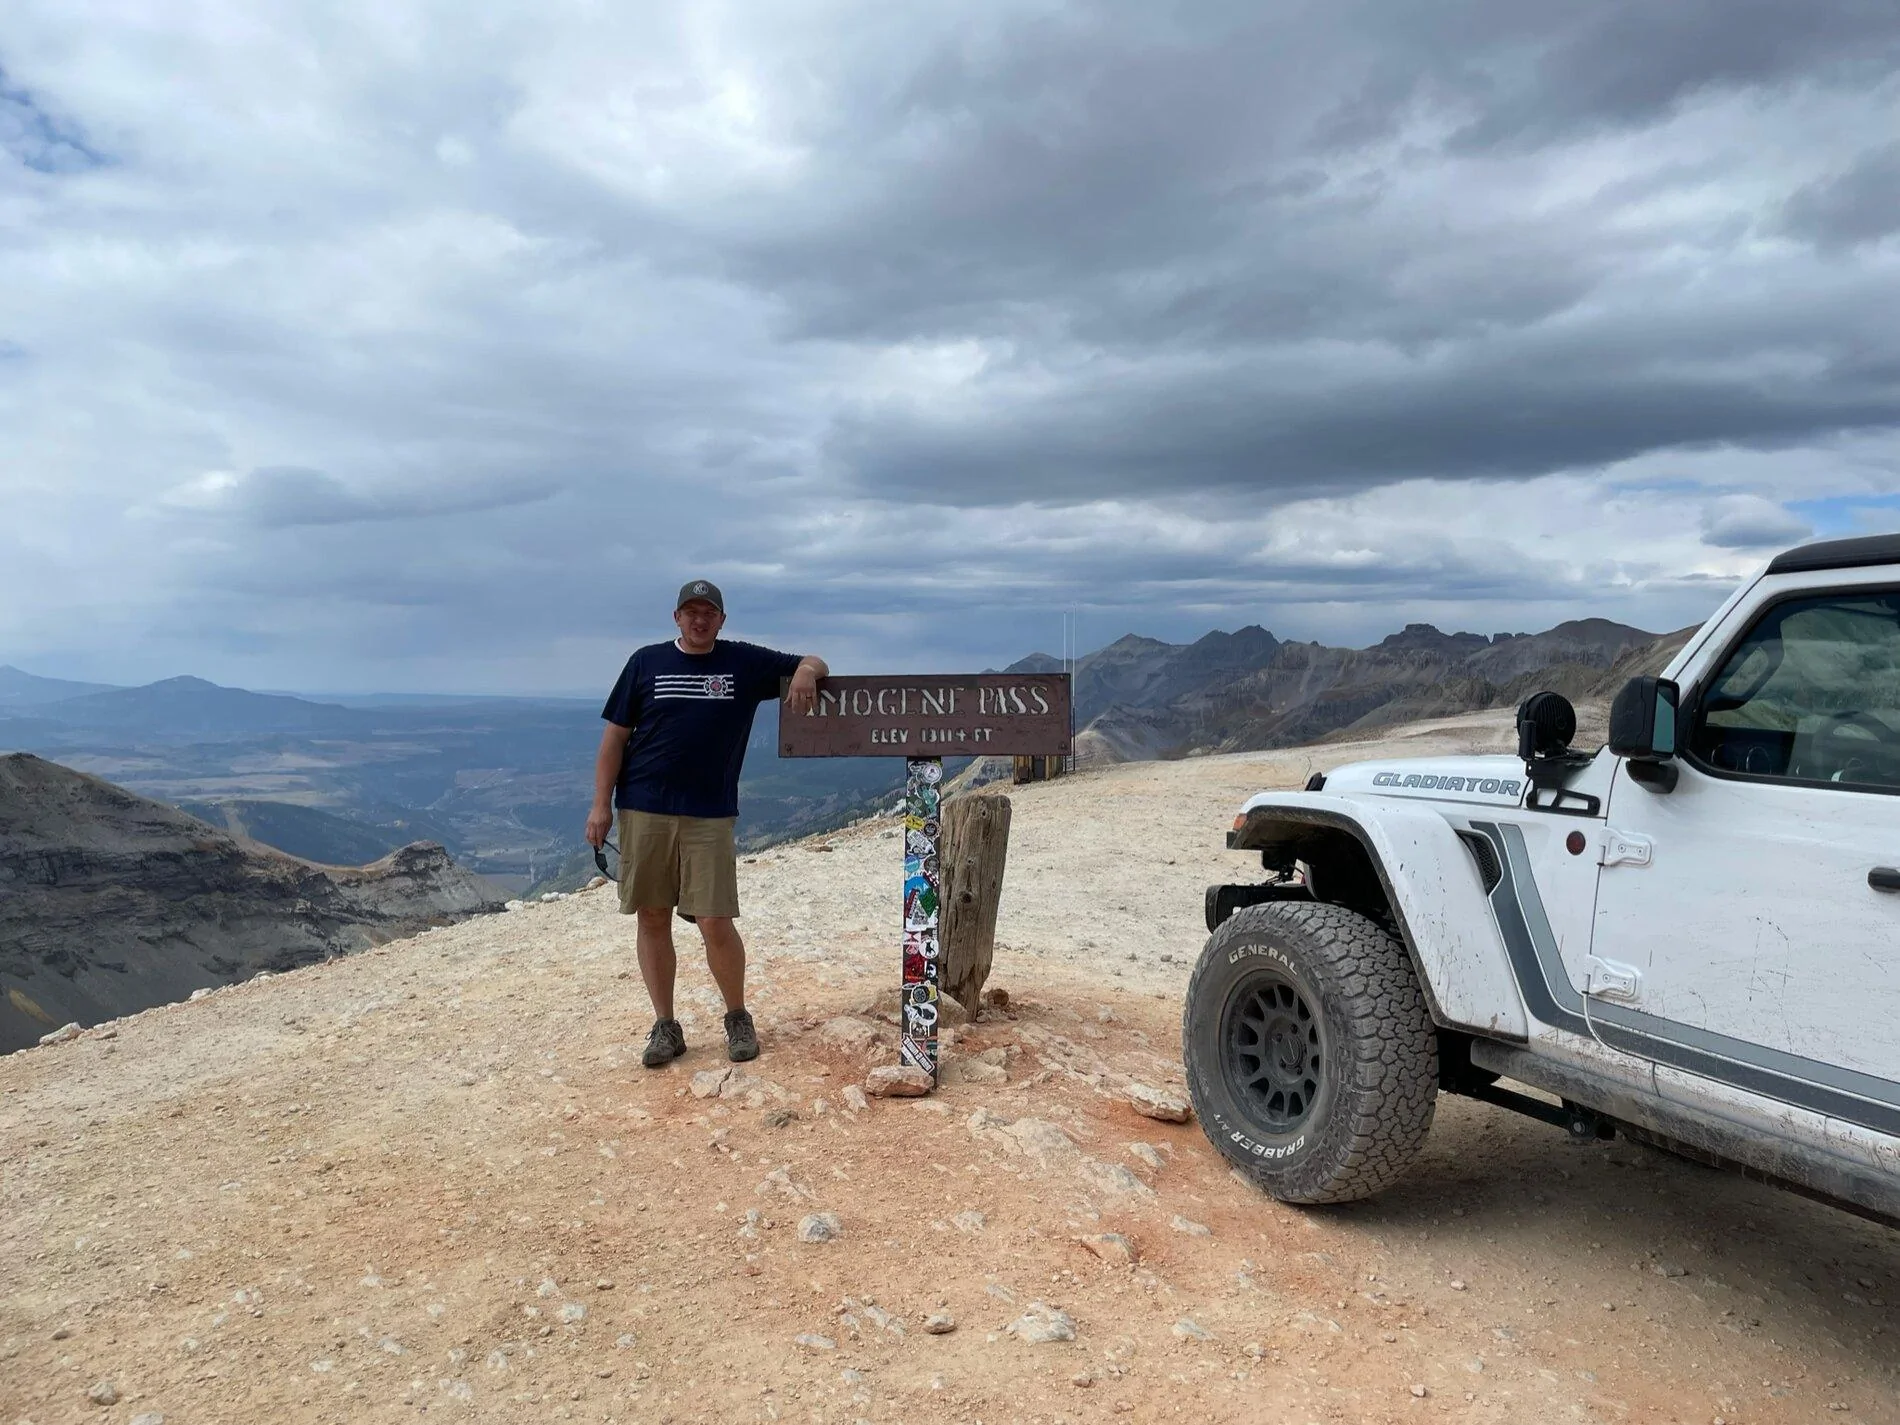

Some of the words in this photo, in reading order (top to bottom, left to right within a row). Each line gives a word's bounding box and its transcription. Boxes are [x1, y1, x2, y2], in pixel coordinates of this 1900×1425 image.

[978, 686, 1049, 716] PASS
[871, 728, 909, 743] ELEV
[974, 728, 993, 742] FT
[1372, 772, 1521, 797] GLADIATOR
[1228, 944, 1298, 976] GENERAL
[1231, 1131, 1305, 1159] GRABBER
